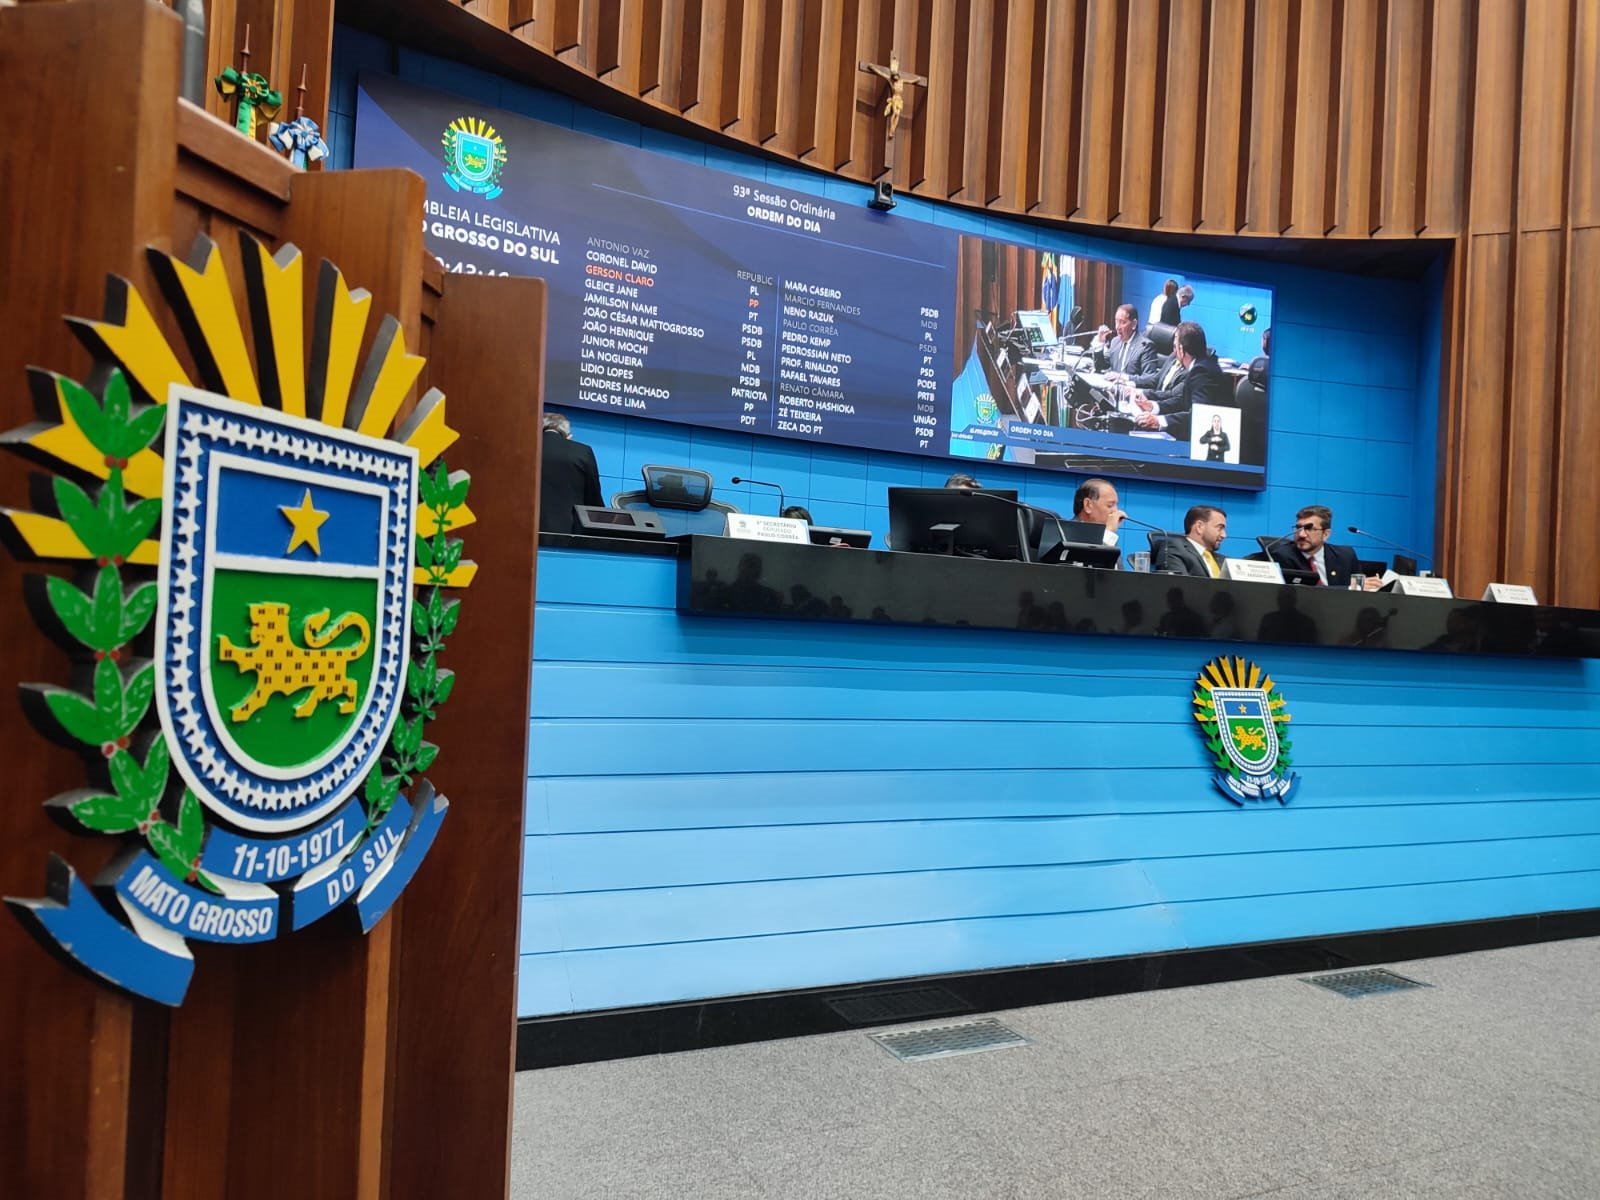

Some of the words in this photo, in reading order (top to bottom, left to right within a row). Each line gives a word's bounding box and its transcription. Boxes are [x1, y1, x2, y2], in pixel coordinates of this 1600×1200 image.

[733, 185, 750, 198] 93ª
[753, 190, 787, 208] Sessão
[790, 199, 836, 220] Ordinária
[747, 206, 784, 224] ORDEM
[786, 215, 801, 228] DO
[804, 219, 821, 233] DIA
[474, 212, 560, 245] LEGISLATIVA
[431, 222, 500, 250] GROSSO
[503, 239, 527, 257] DO
[530, 245, 560, 265] SUL
[587, 237, 629, 254] ANTONIO
[631, 246, 650, 259] VAZ
[586, 250, 629, 270] CORONEL
[631, 260, 657, 274] DAVID
[585, 264, 622, 280] GERSON
[625, 273, 654, 287] CLARO
[736, 270, 774, 286] REPUBLIC
[585, 278, 614, 293] GLEICE
[616, 285, 638, 298] JANE
[750, 285, 759, 296] PL
[784, 280, 807, 293] MARA
[809, 285, 841, 300] CASEIRO
[584, 292, 628, 310] JAMILSON
[631, 301, 658, 316] NAME
[749, 299, 759, 308] PP
[817, 300, 861, 315] FERNANDES
[748, 312, 758, 321] PT
[783, 305, 806, 318] NENO
[808, 311, 834, 323] RAZUK
[920, 307, 939, 318] PSDB
[583, 306, 607, 319] JOÃO
[609, 310, 638, 325] CÉSAR
[640, 318, 704, 338] MATTOGROSSO
[742, 323, 763, 335] PSDB
[783, 318, 807, 331] PAULO
[809, 324, 839, 337] CORRÊA
[921, 320, 938, 330] MDB
[582, 320, 607, 333] JOÃO
[609, 325, 654, 342] HENRIQUE
[782, 331, 808, 344] PEDRO
[810, 336, 831, 347] KEMP
[925, 332, 933, 341] PL
[582, 334, 615, 349] JUNIOR
[617, 341, 648, 355] MOCHI
[741, 337, 762, 348] PSDB
[919, 343, 937, 354] PSDB
[581, 348, 595, 359] LIA
[597, 351, 643, 368] NOGUEIRA
[747, 351, 756, 360] PL
[781, 343, 829, 360] PEDROSSIAN
[831, 353, 851, 364] NETO
[923, 356, 932, 365] PT
[580, 362, 604, 374] LIDIO
[607, 367, 633, 380] LOPES
[741, 363, 760, 374] MDB
[781, 356, 803, 369] PROF.
[804, 361, 838, 374] RINALDO
[920, 368, 934, 378] PSD
[740, 376, 760, 387] PSDB
[780, 369, 807, 382] RAFAEL
[809, 374, 841, 387] TAVARES
[917, 379, 937, 390] PODE
[580, 376, 621, 391] LONDRES
[623, 383, 670, 399] MACHADO
[731, 387, 767, 401] PATRIOTA
[780, 383, 809, 395] RENATO
[579, 390, 607, 403] LUCAS
[610, 395, 622, 406] DE
[624, 398, 646, 409] LIMA
[744, 402, 754, 411] PP
[779, 395, 814, 408] ROBERTO
[816, 401, 855, 414] HASHIOKA
[740, 415, 756, 426] PDT
[778, 407, 788, 418] ZÉ
[790, 410, 821, 422] TEIXEIRA
[913, 415, 937, 426] UNIÃO
[777, 421, 797, 432] ZECA
[800, 423, 811, 434] DO
[813, 426, 823, 435] PT
[915, 427, 934, 437] PSDB
[1010, 426, 1032, 435] ORDEM
[1033, 428, 1042, 436] DO
[1043, 430, 1054, 438] DIA
[920, 440, 929, 448] PT
[232, 819, 346, 879] 11-10-1977
[128, 865, 187, 924] MATO
[189, 907, 273, 938] GROSSO
[326, 868, 355, 906] DO
[363, 824, 405, 873] SUL
